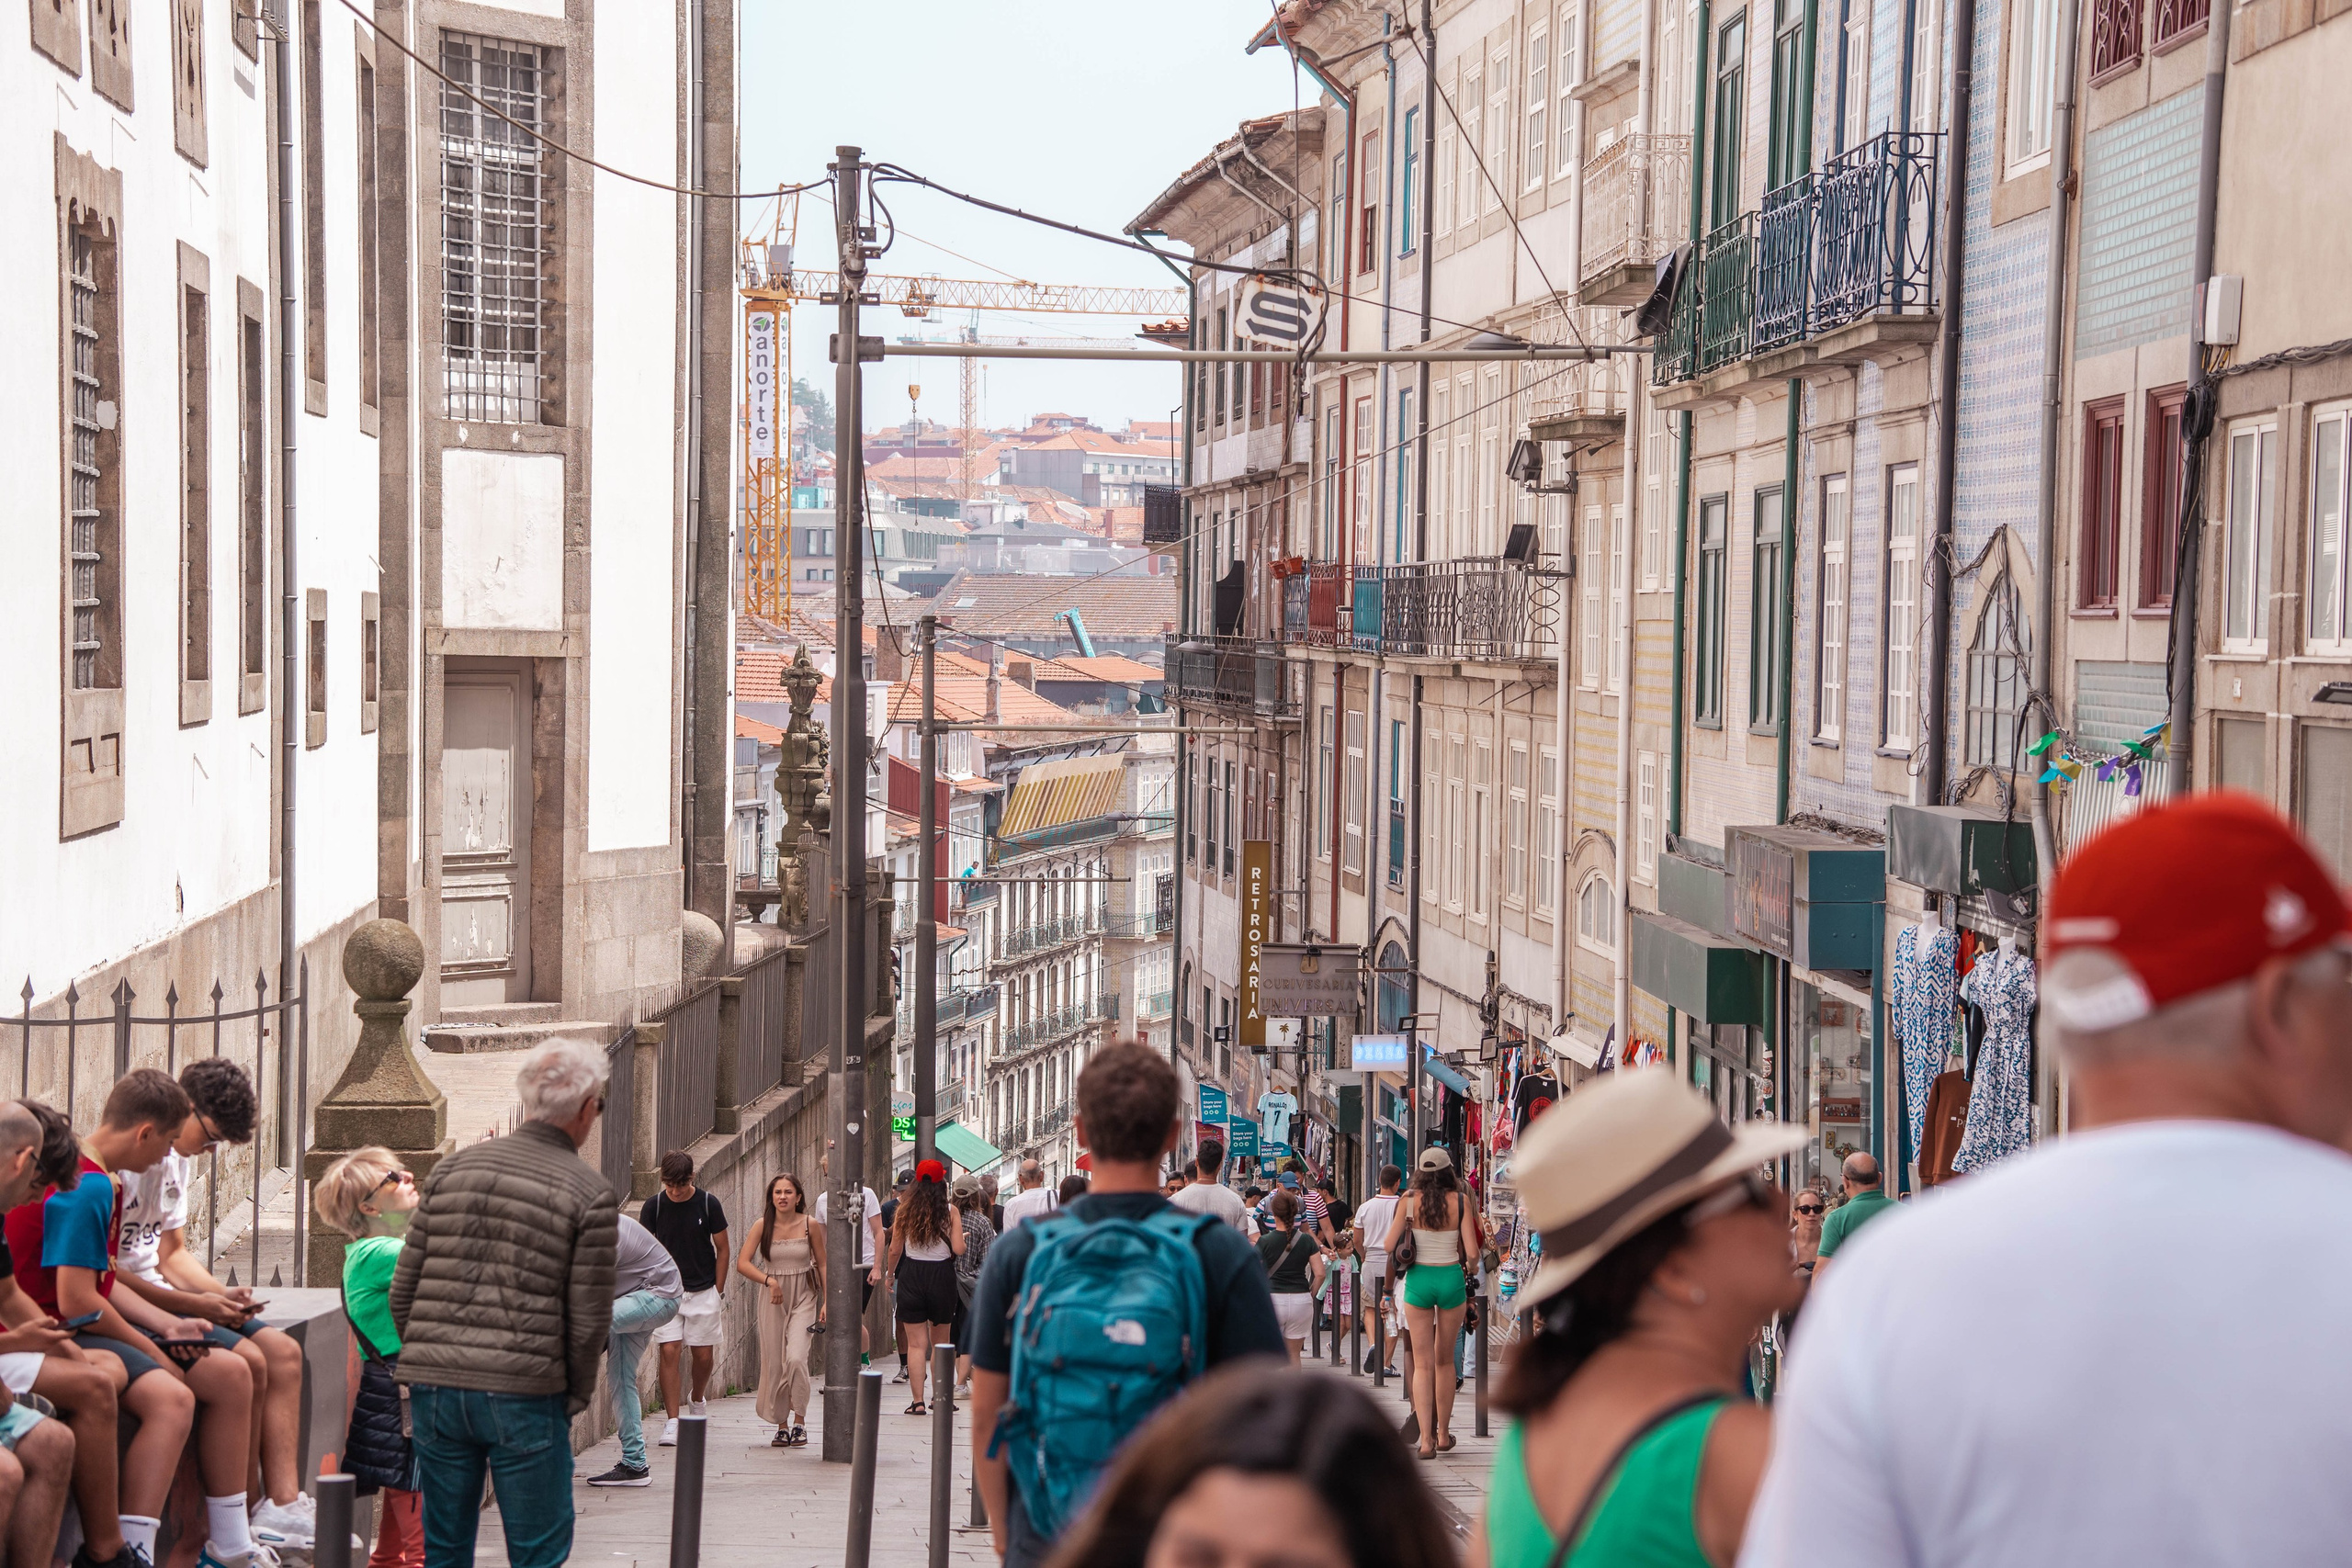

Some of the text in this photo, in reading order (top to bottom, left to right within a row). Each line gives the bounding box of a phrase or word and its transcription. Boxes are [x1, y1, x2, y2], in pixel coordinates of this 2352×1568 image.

[756, 336, 768, 440] anorte
[1247, 867, 1261, 1020] RETROSARIA
[1263, 978, 1354, 990] OURIVESARIA
[1261, 998, 1357, 1013] UNIVERSAL
[1274, 1110, 1281, 1126] 7
